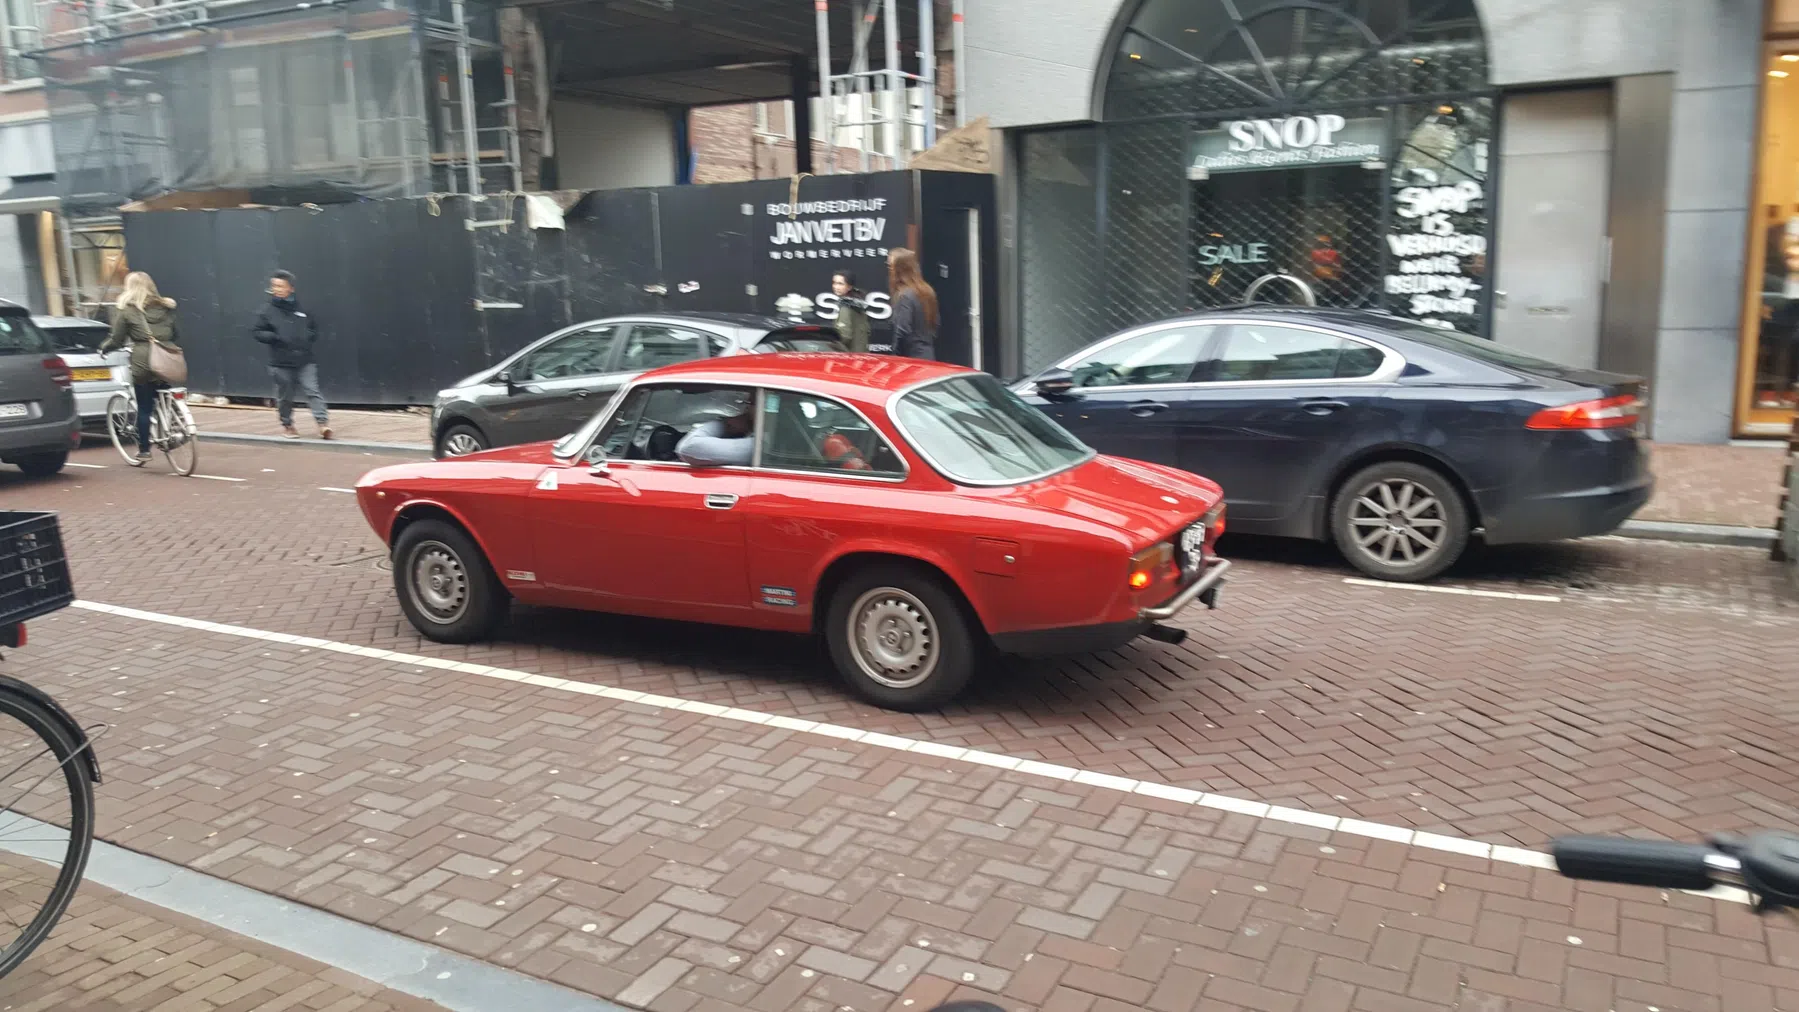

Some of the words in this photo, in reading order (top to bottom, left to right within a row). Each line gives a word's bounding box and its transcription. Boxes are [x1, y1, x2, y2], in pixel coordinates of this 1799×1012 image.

[1229, 114, 1346, 152] SNOP
[766, 198, 887, 216] BOUWBEDRIJF
[1198, 242, 1269, 265] SALE
